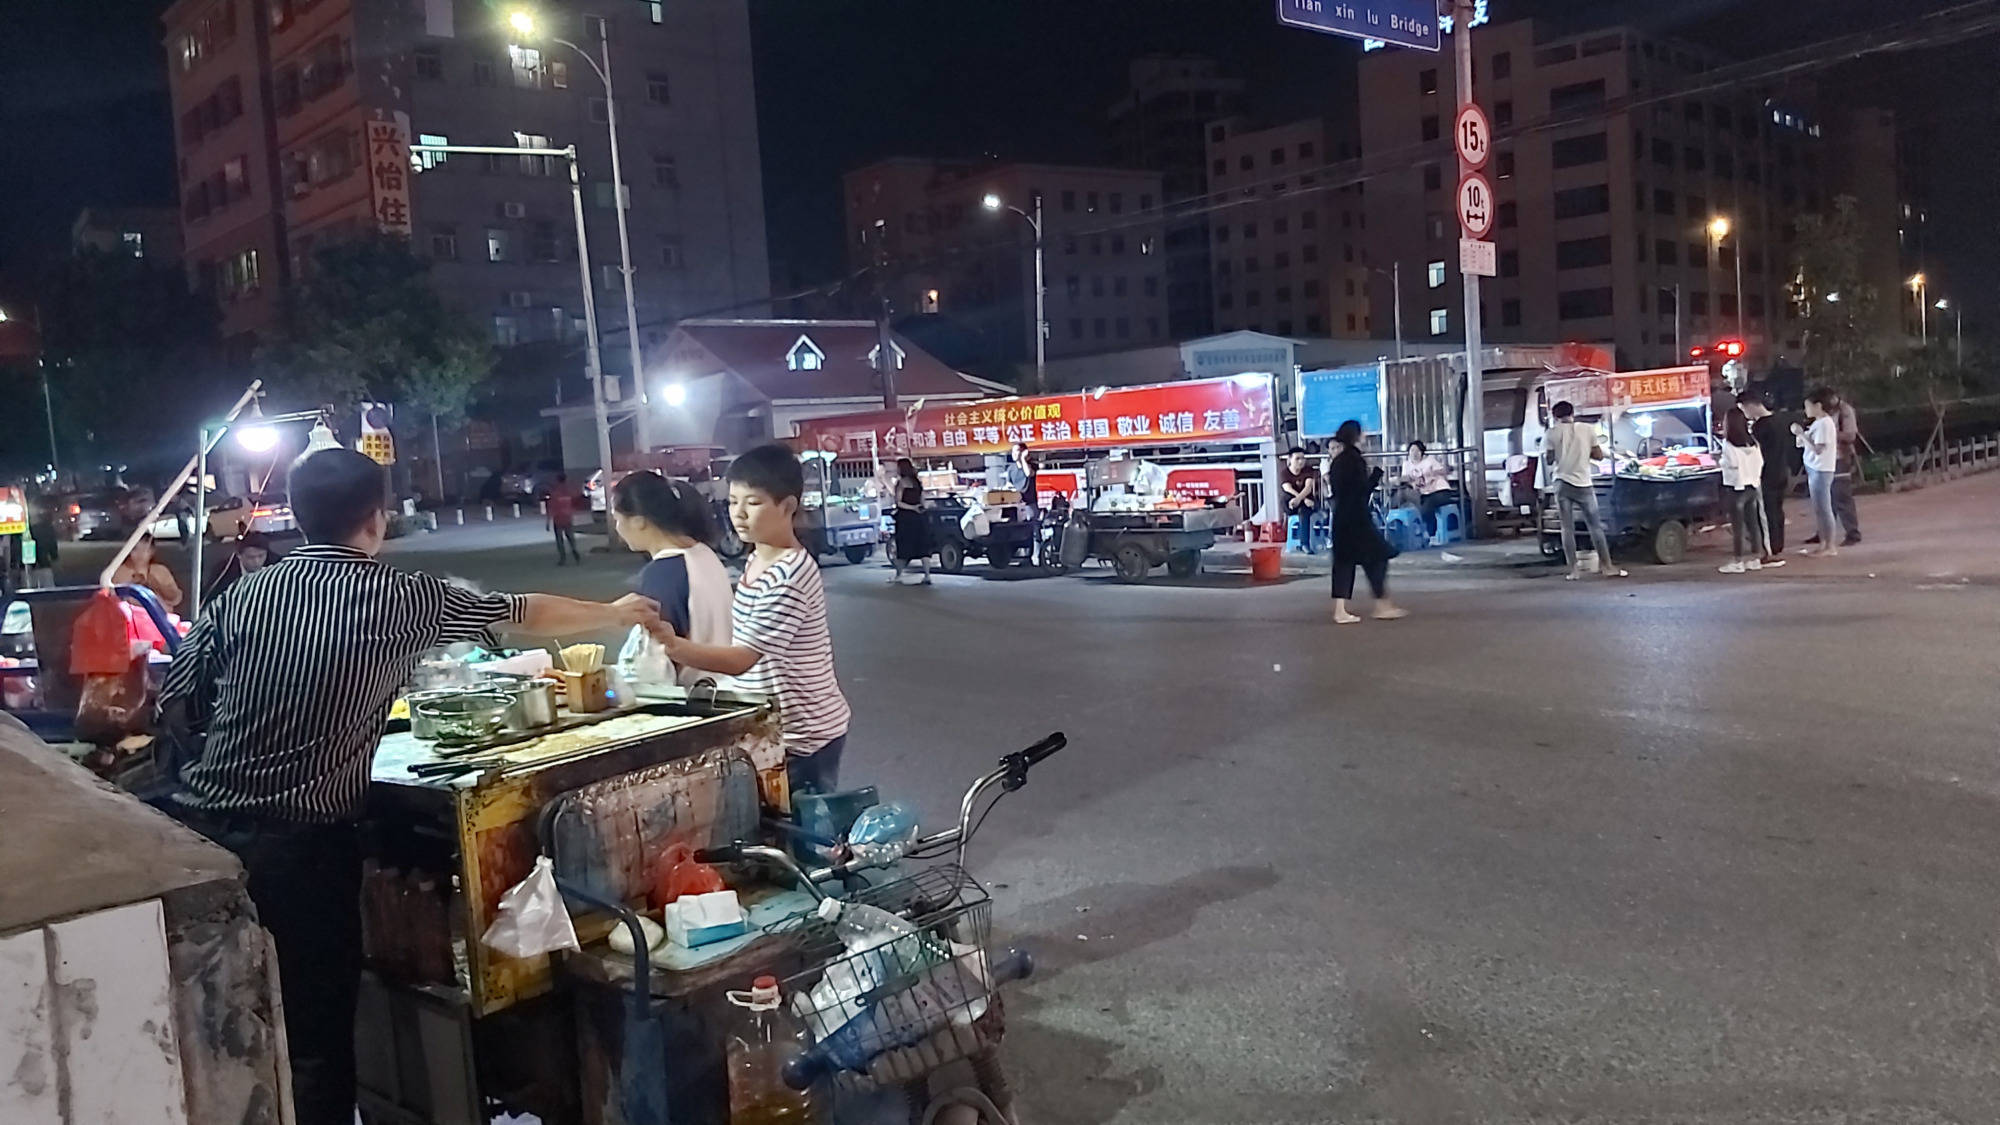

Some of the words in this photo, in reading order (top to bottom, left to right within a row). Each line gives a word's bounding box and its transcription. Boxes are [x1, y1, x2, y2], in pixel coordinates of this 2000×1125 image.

[1335, 3, 1355, 20] xin
[1367, 9, 1379, 25] lu
[1391, 14, 1429, 37] Bridge
[942, 429, 968, 447] 自由
[973, 426, 1000, 445] 平等
[1006, 423, 1036, 443] 公正
[1041, 421, 1072, 441] 法治
[1078, 418, 1110, 439] 爱国
[1117, 415, 1150, 437] 敬业
[1159, 411, 1194, 434] 诚信
[1203, 408, 1241, 431] 友善
[944, 403, 1061, 427] 社会主义核心价值观
